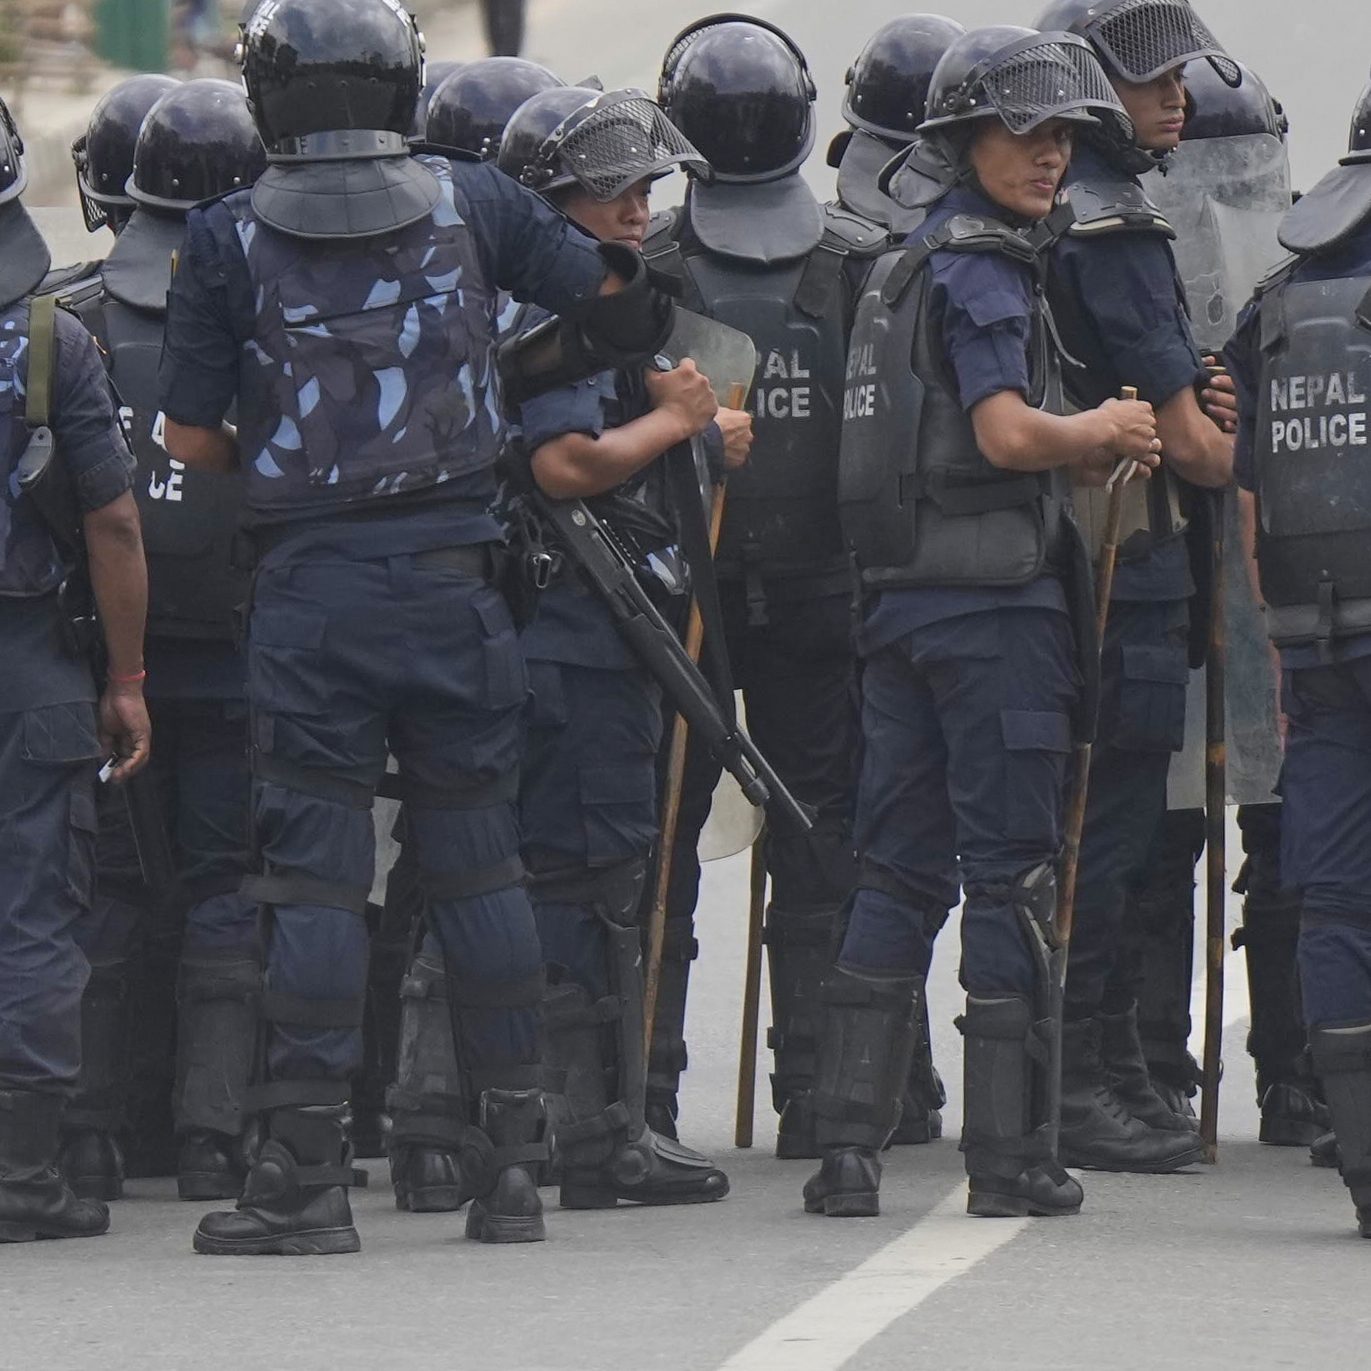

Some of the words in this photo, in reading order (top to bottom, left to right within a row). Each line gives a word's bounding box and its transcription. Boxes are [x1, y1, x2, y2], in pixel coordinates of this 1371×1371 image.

[756, 387, 810, 418] ICE
[1271, 371, 1365, 411] NEPAL
[1272, 413, 1367, 453] POLICE
